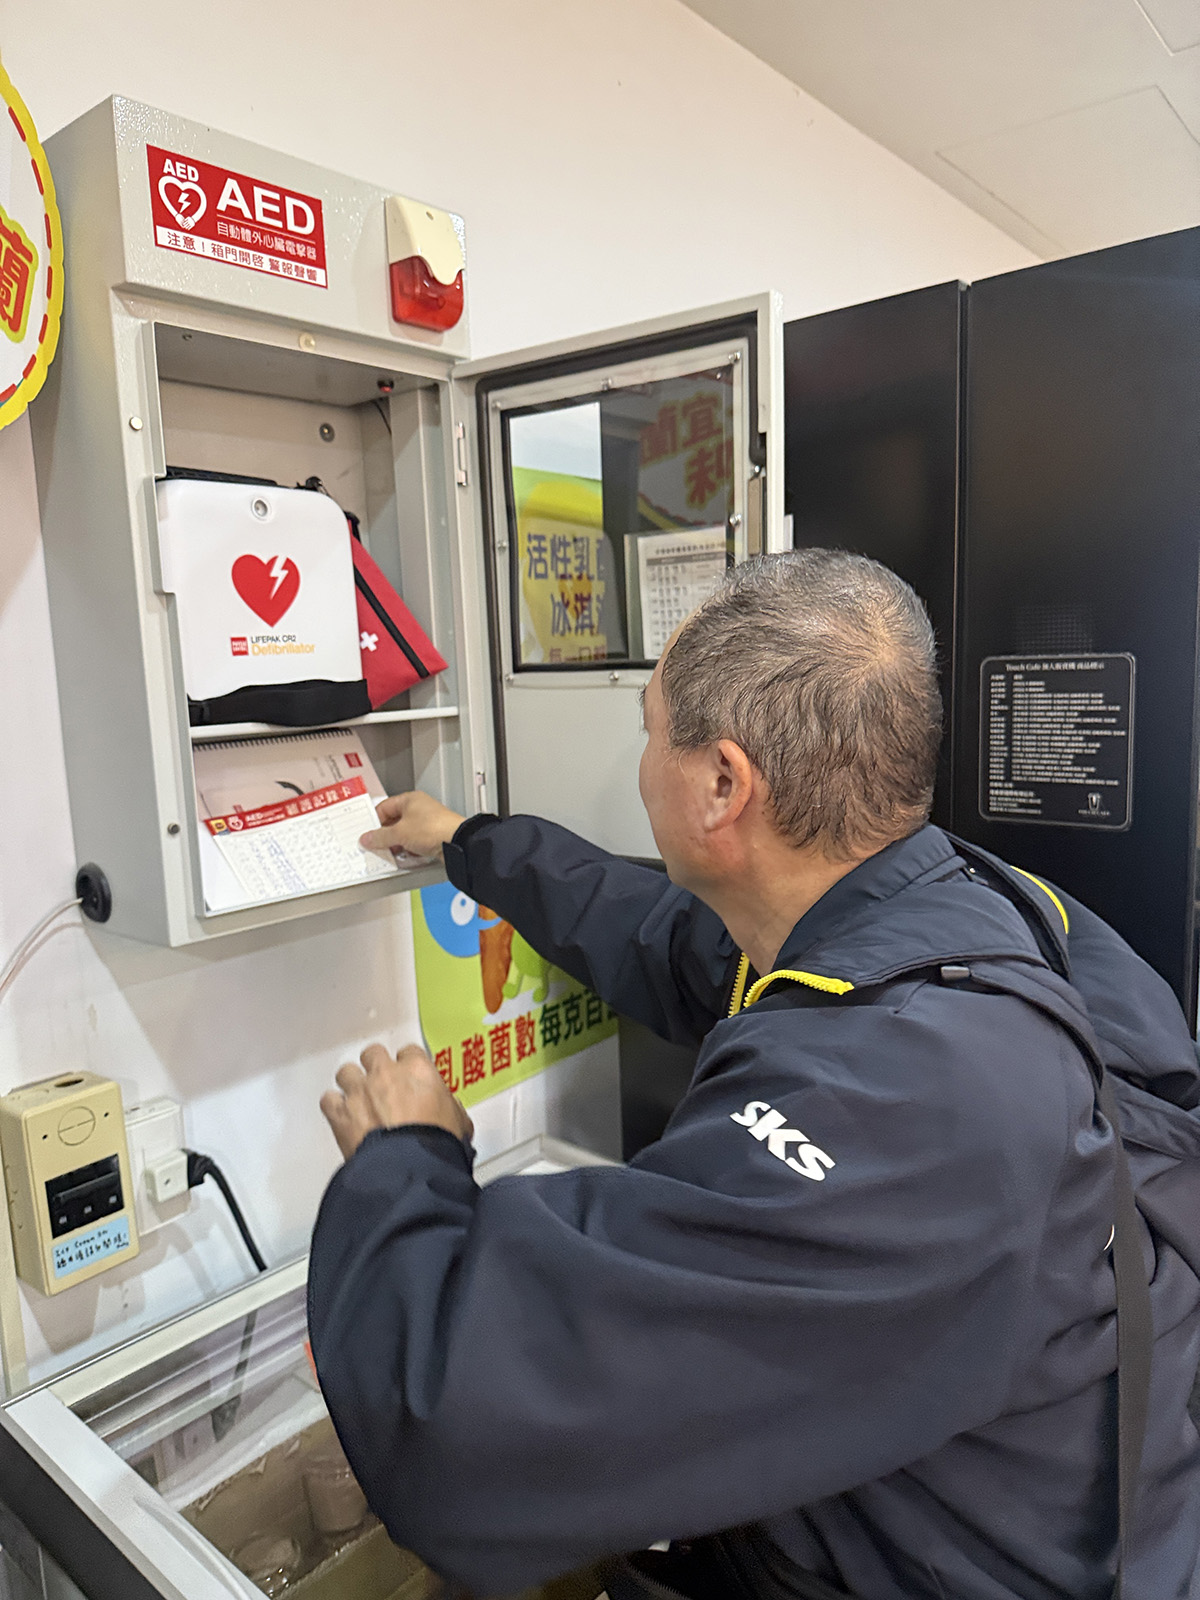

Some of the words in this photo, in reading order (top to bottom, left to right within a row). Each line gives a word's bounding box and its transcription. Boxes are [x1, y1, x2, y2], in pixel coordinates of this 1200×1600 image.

[163, 158, 200, 183] AED
[216, 177, 316, 235] AED
[217, 221, 317, 261] 自動體外心臟電擊器
[250, 635, 281, 644] LIFEPAK
[251, 643, 316, 656] Defibrillator
[729, 1101, 836, 1181] SKS
